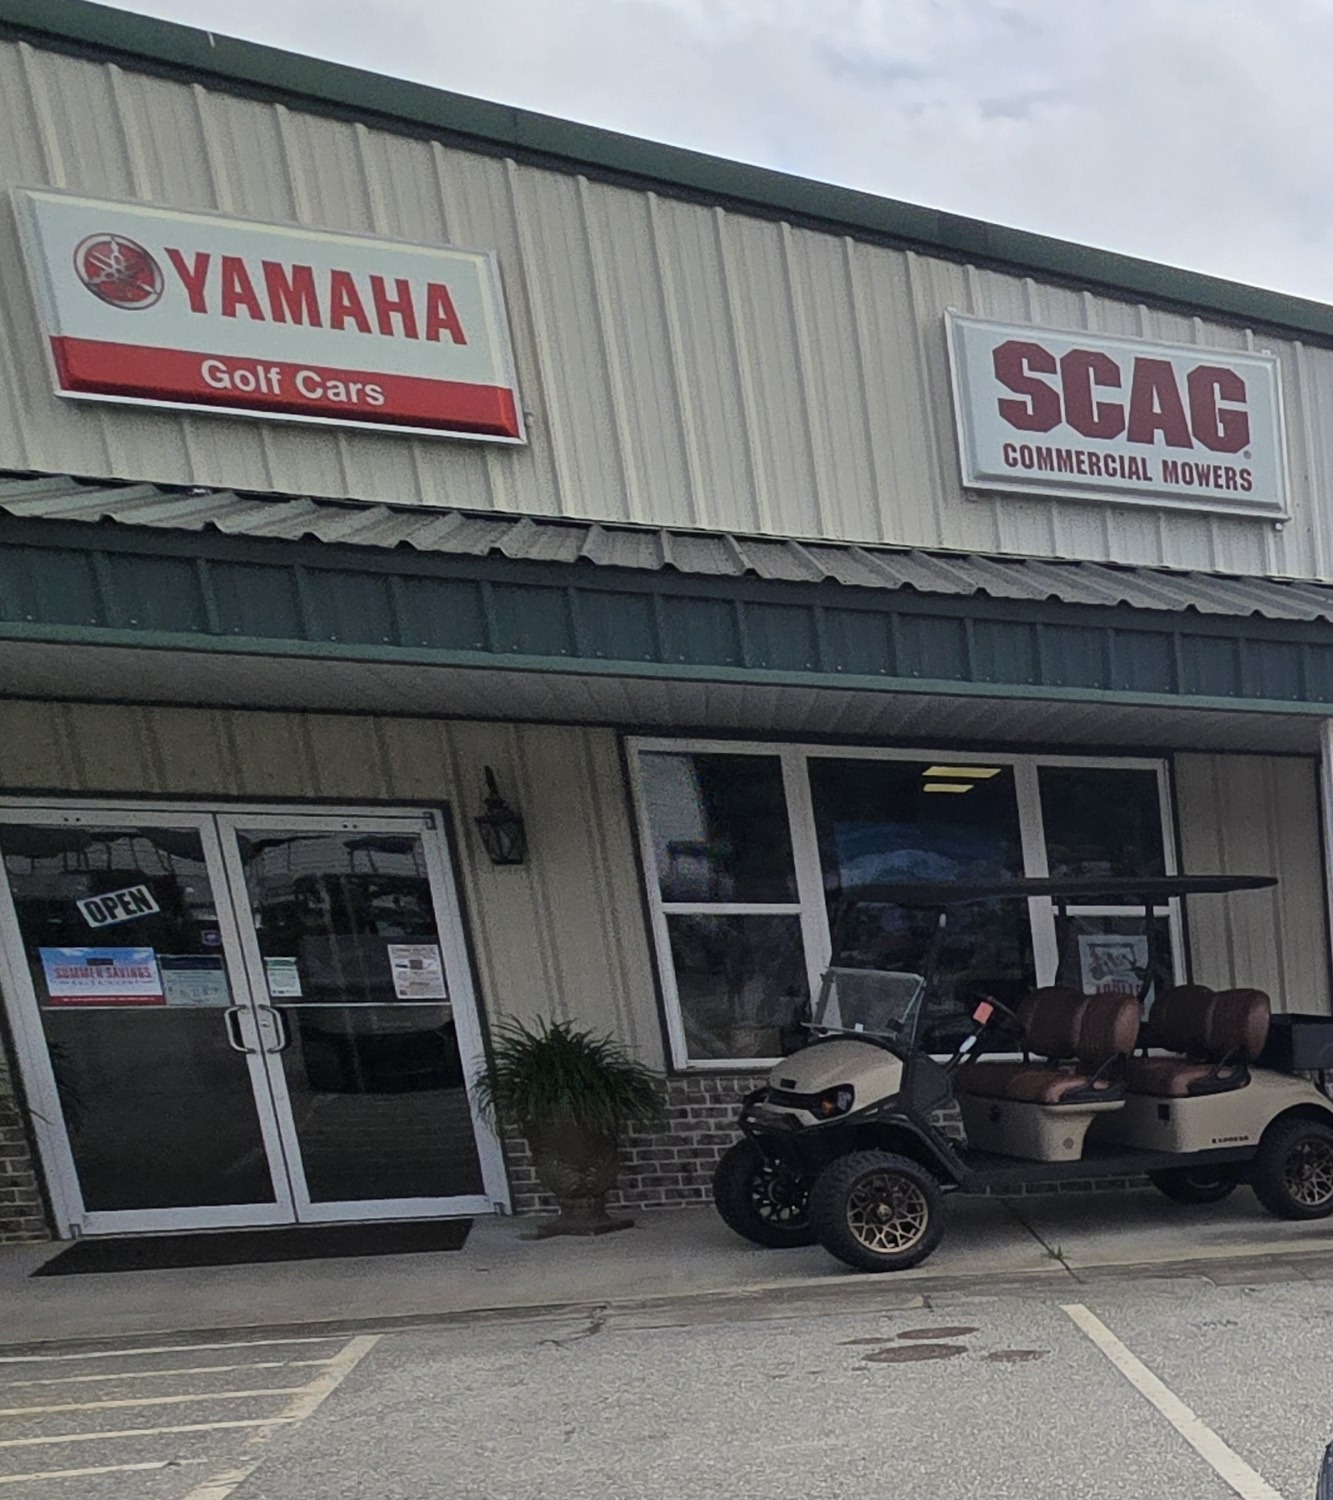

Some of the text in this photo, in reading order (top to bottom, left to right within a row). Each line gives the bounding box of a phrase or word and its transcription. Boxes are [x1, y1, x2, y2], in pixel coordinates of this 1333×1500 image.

[163, 247, 468, 345] YAMAHA
[201, 359, 386, 406] Golf Cars
[992, 340, 1251, 454] SCAG
[1002, 443, 1253, 492] COMMERCIAL MOWERS
[83, 887, 154, 924] OPEN
[54, 966, 151, 980] SUMMER SAVINGS
